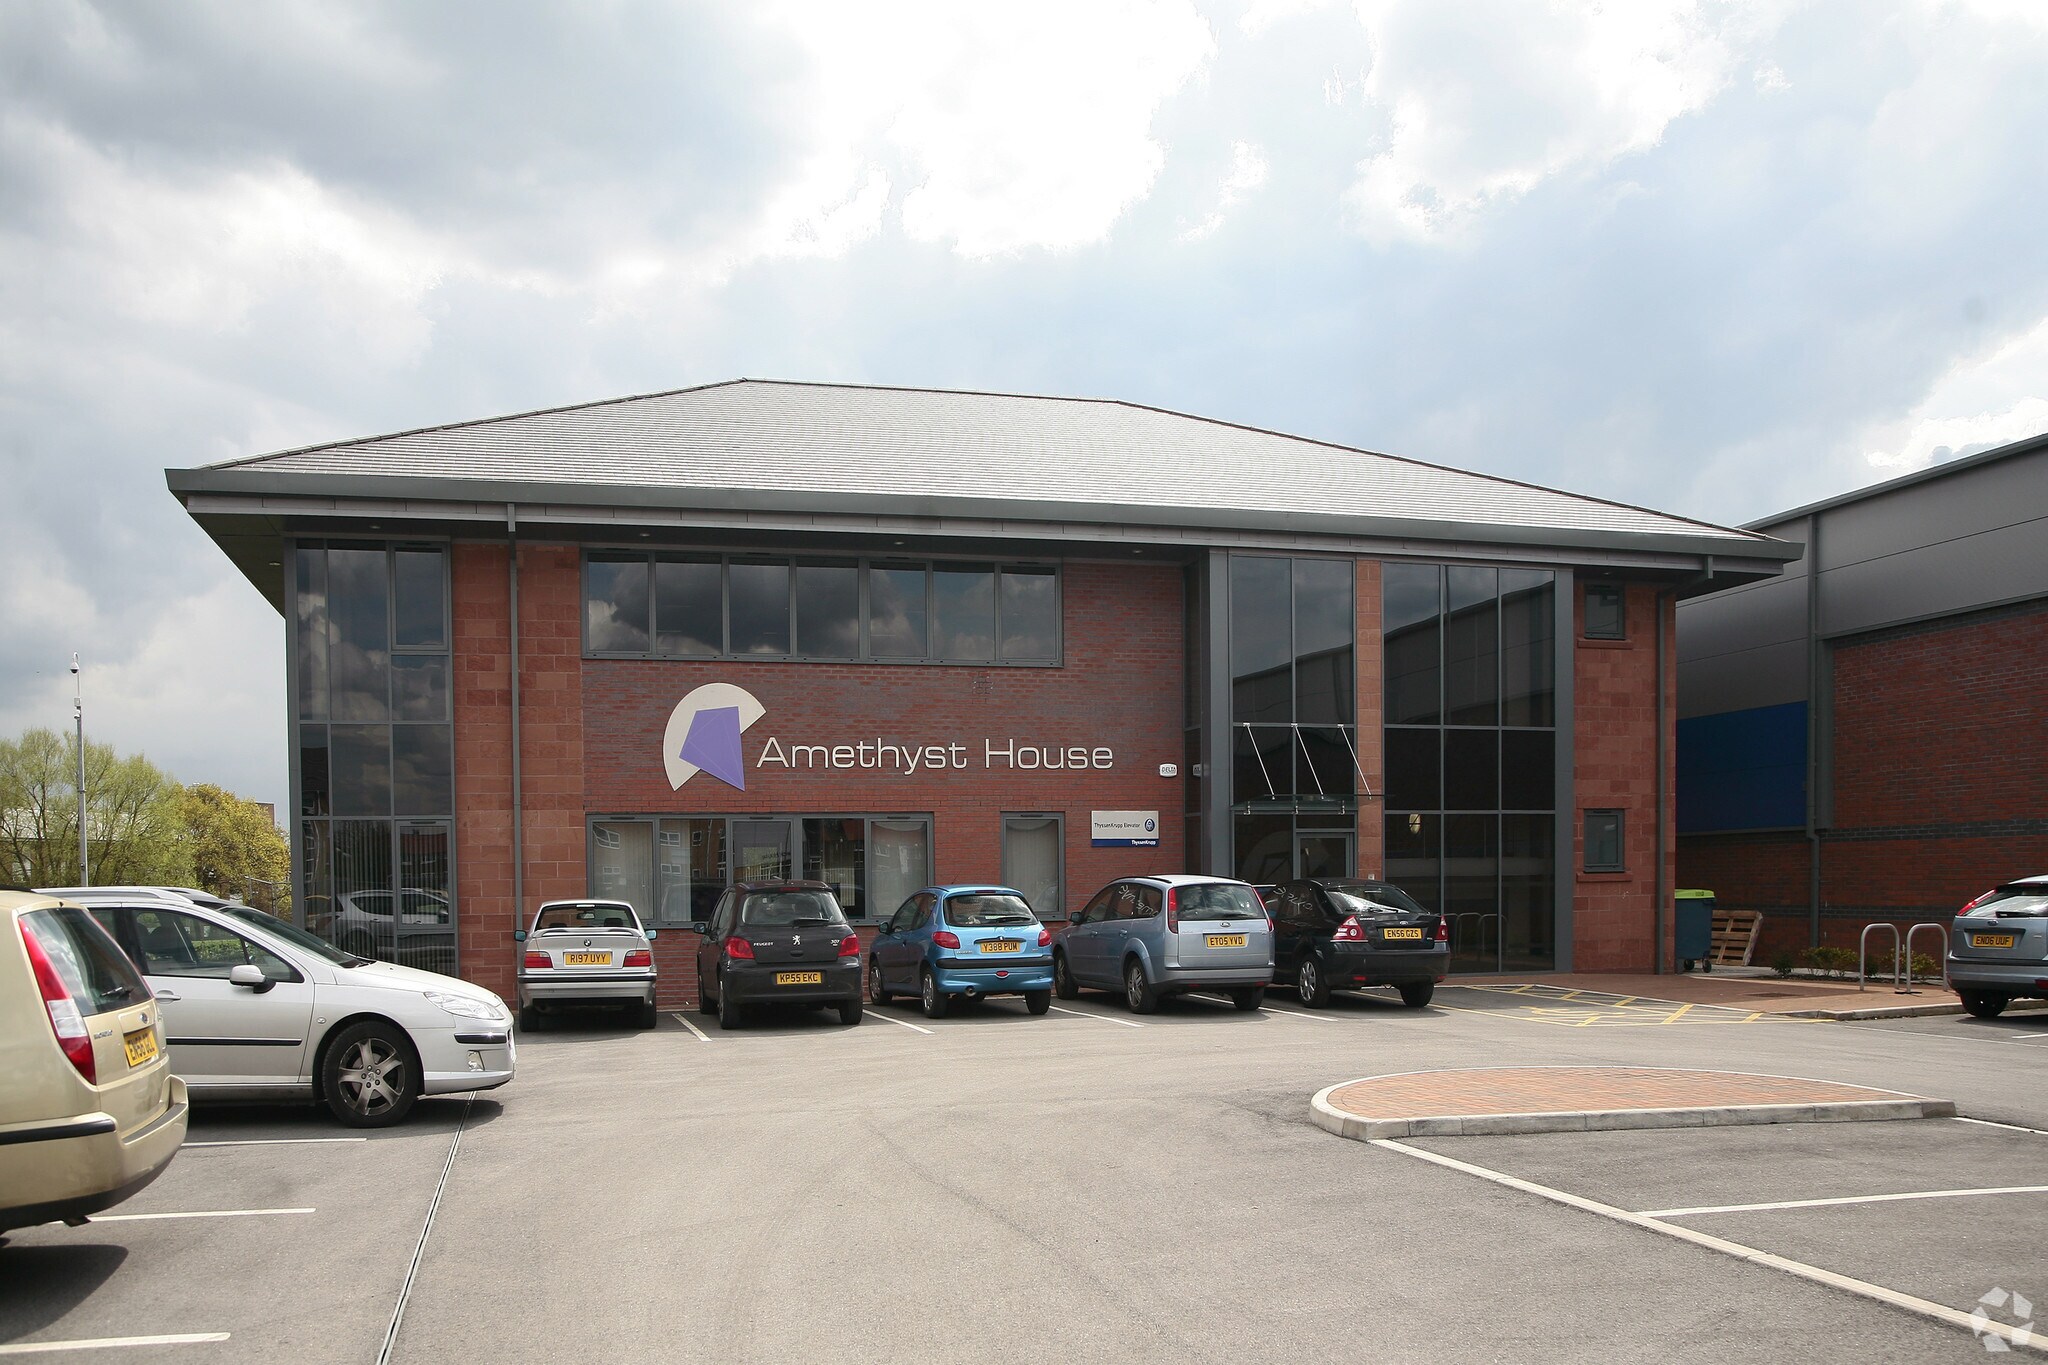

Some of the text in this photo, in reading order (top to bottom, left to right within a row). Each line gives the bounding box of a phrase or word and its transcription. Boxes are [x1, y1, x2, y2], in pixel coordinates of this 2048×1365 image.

[756, 736, 1113, 775] Amethyst House
[1210, 937, 1228, 945] ET05
[1976, 936, 1994, 945] EN06
[1004, 942, 1018, 951] PUM
[570, 954, 606, 963] R197 UYY
[780, 973, 818, 983] KP55 EKC
